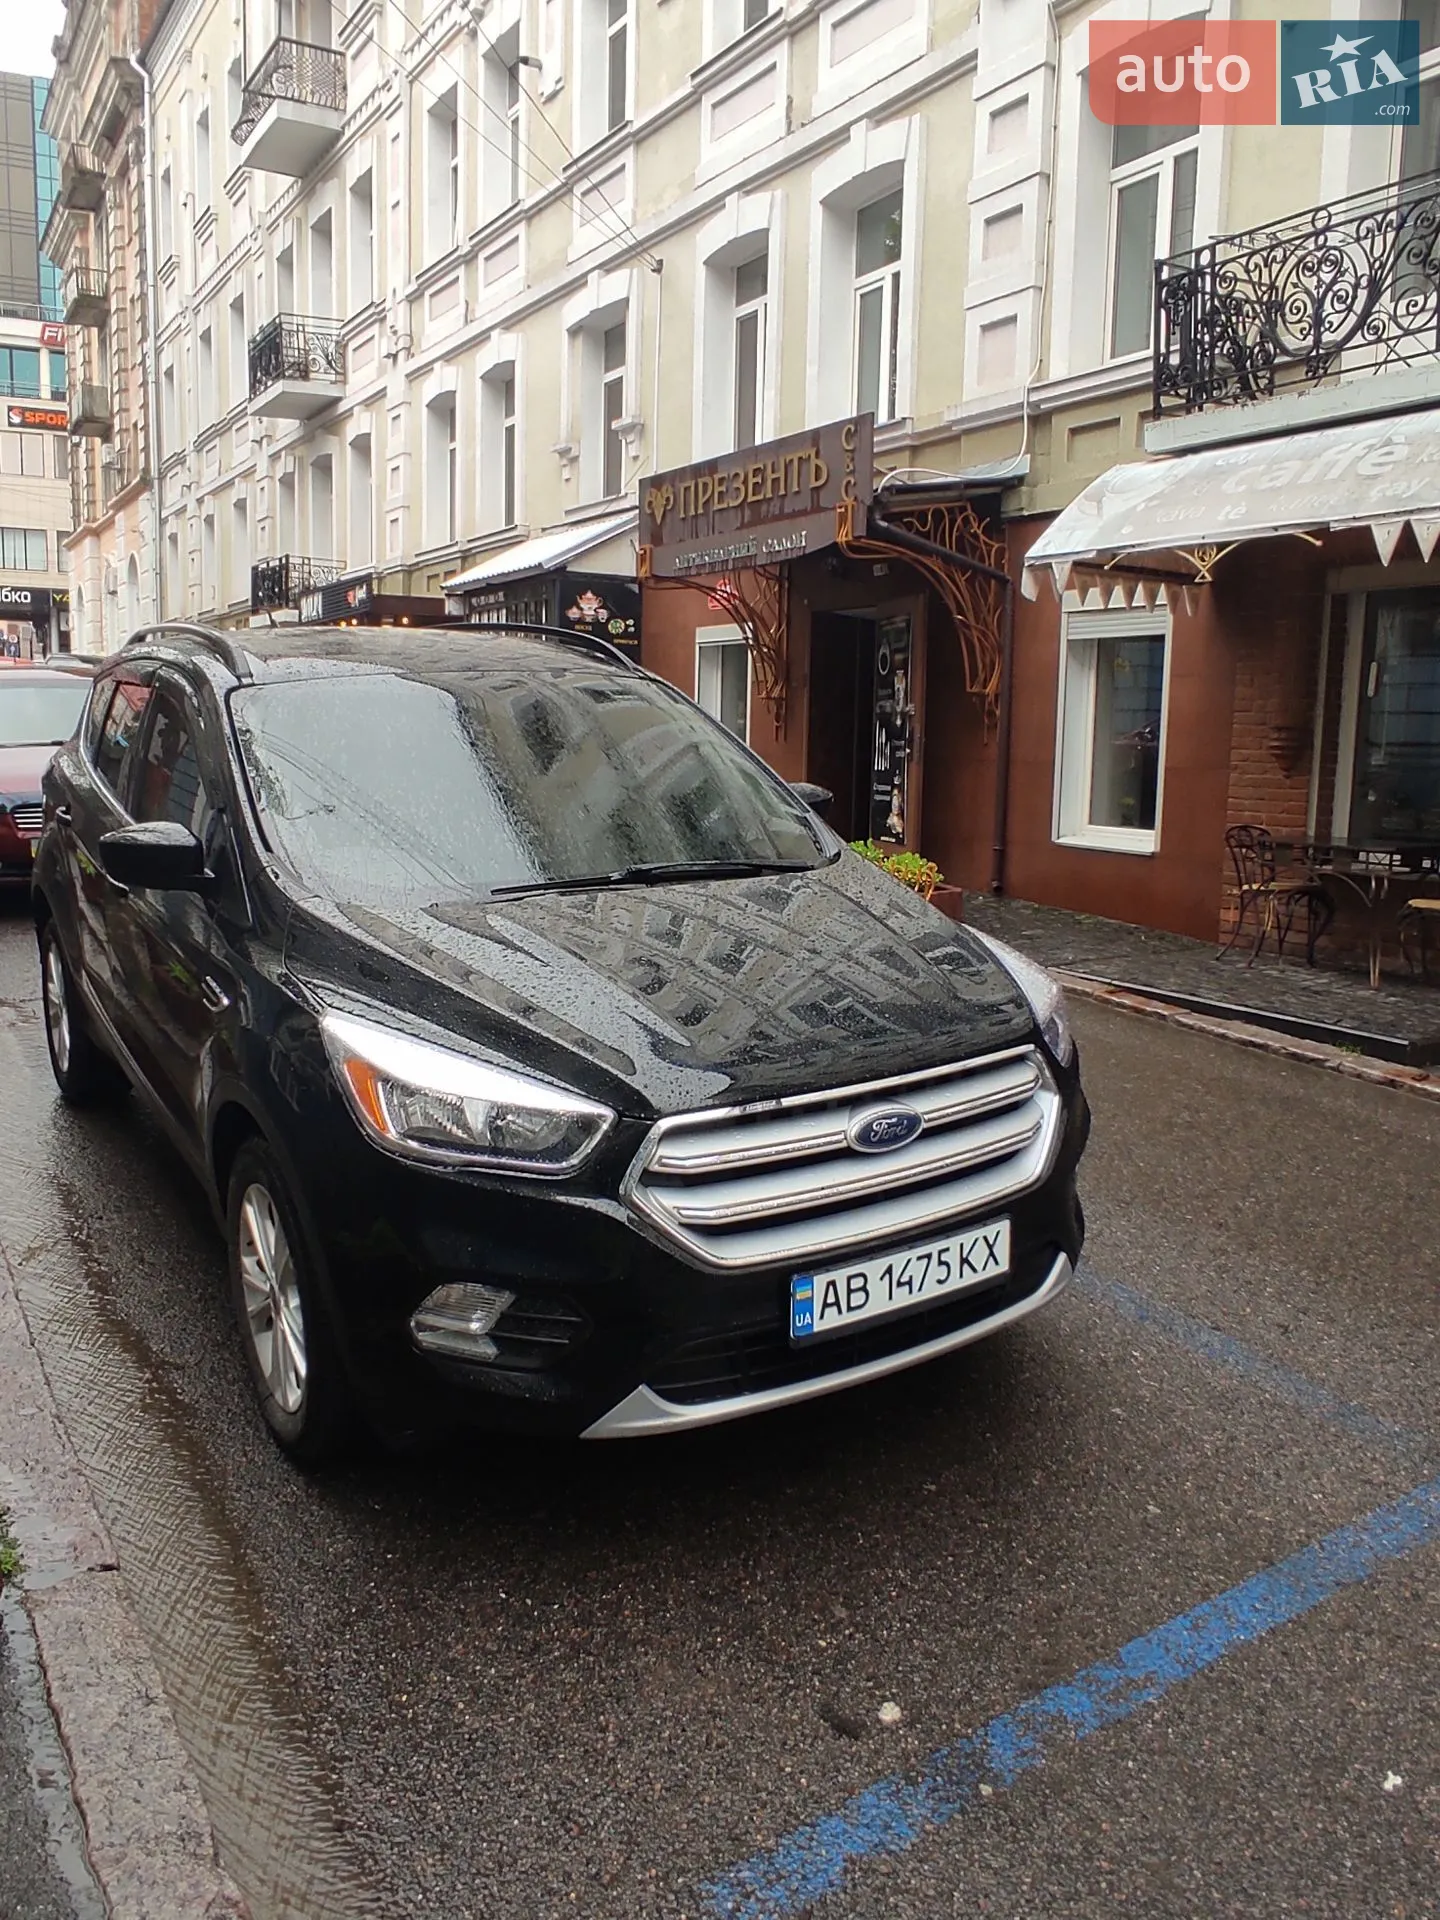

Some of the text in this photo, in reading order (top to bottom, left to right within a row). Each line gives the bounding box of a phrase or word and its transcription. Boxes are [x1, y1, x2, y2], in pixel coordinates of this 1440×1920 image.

[679, 448, 829, 519] ПРЕЗЕНТЪ
[0, 587, 31, 603] бко
[870, 1117, 908, 1142] Ford
[819, 1229, 1001, 1320] AB 1475 KX
[795, 1312, 812, 1327] UA
